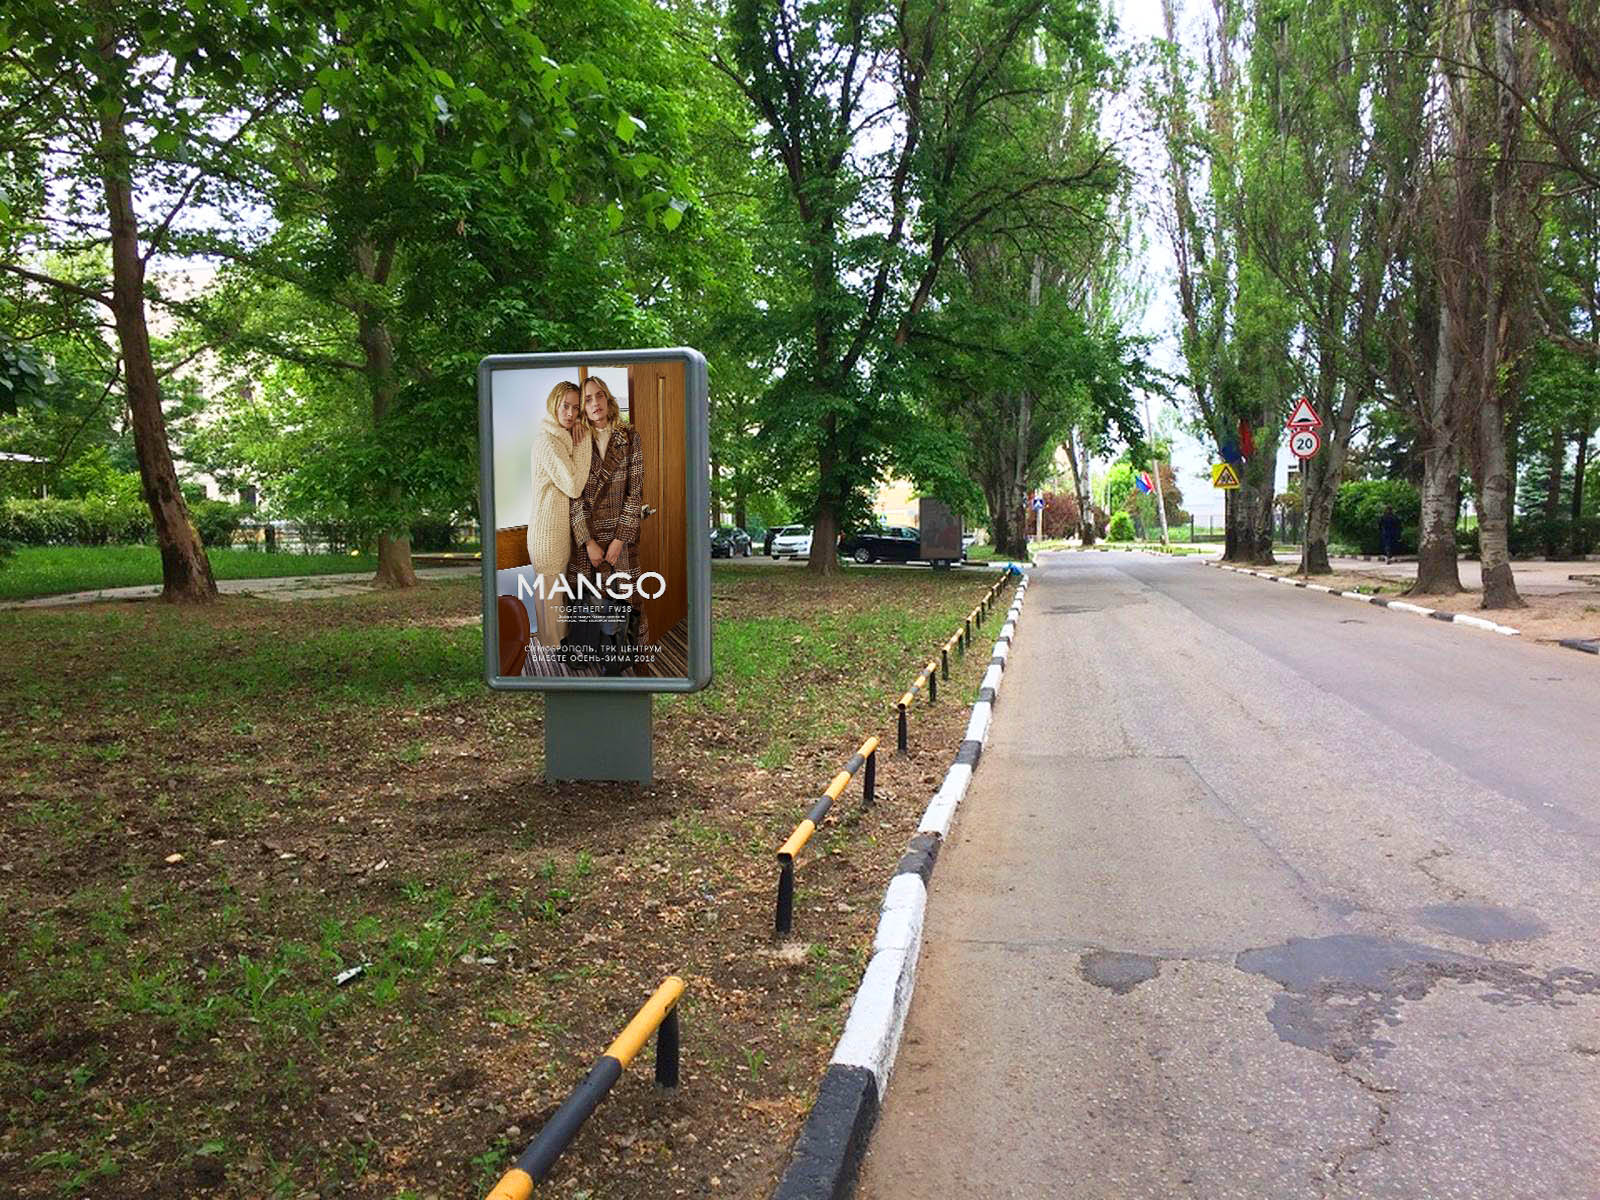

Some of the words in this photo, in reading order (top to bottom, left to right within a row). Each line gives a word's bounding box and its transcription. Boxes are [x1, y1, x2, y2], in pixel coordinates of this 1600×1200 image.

[1297, 438, 1313, 450] 20
[517, 571, 666, 600] MANGO
[608, 605, 632, 613] FW18
[621, 645, 662, 653] ЦЕНТРУМ
[532, 654, 567, 662] ВМЕСТЕ
[570, 654, 631, 662] ОСЕНЬ-ЗИМА
